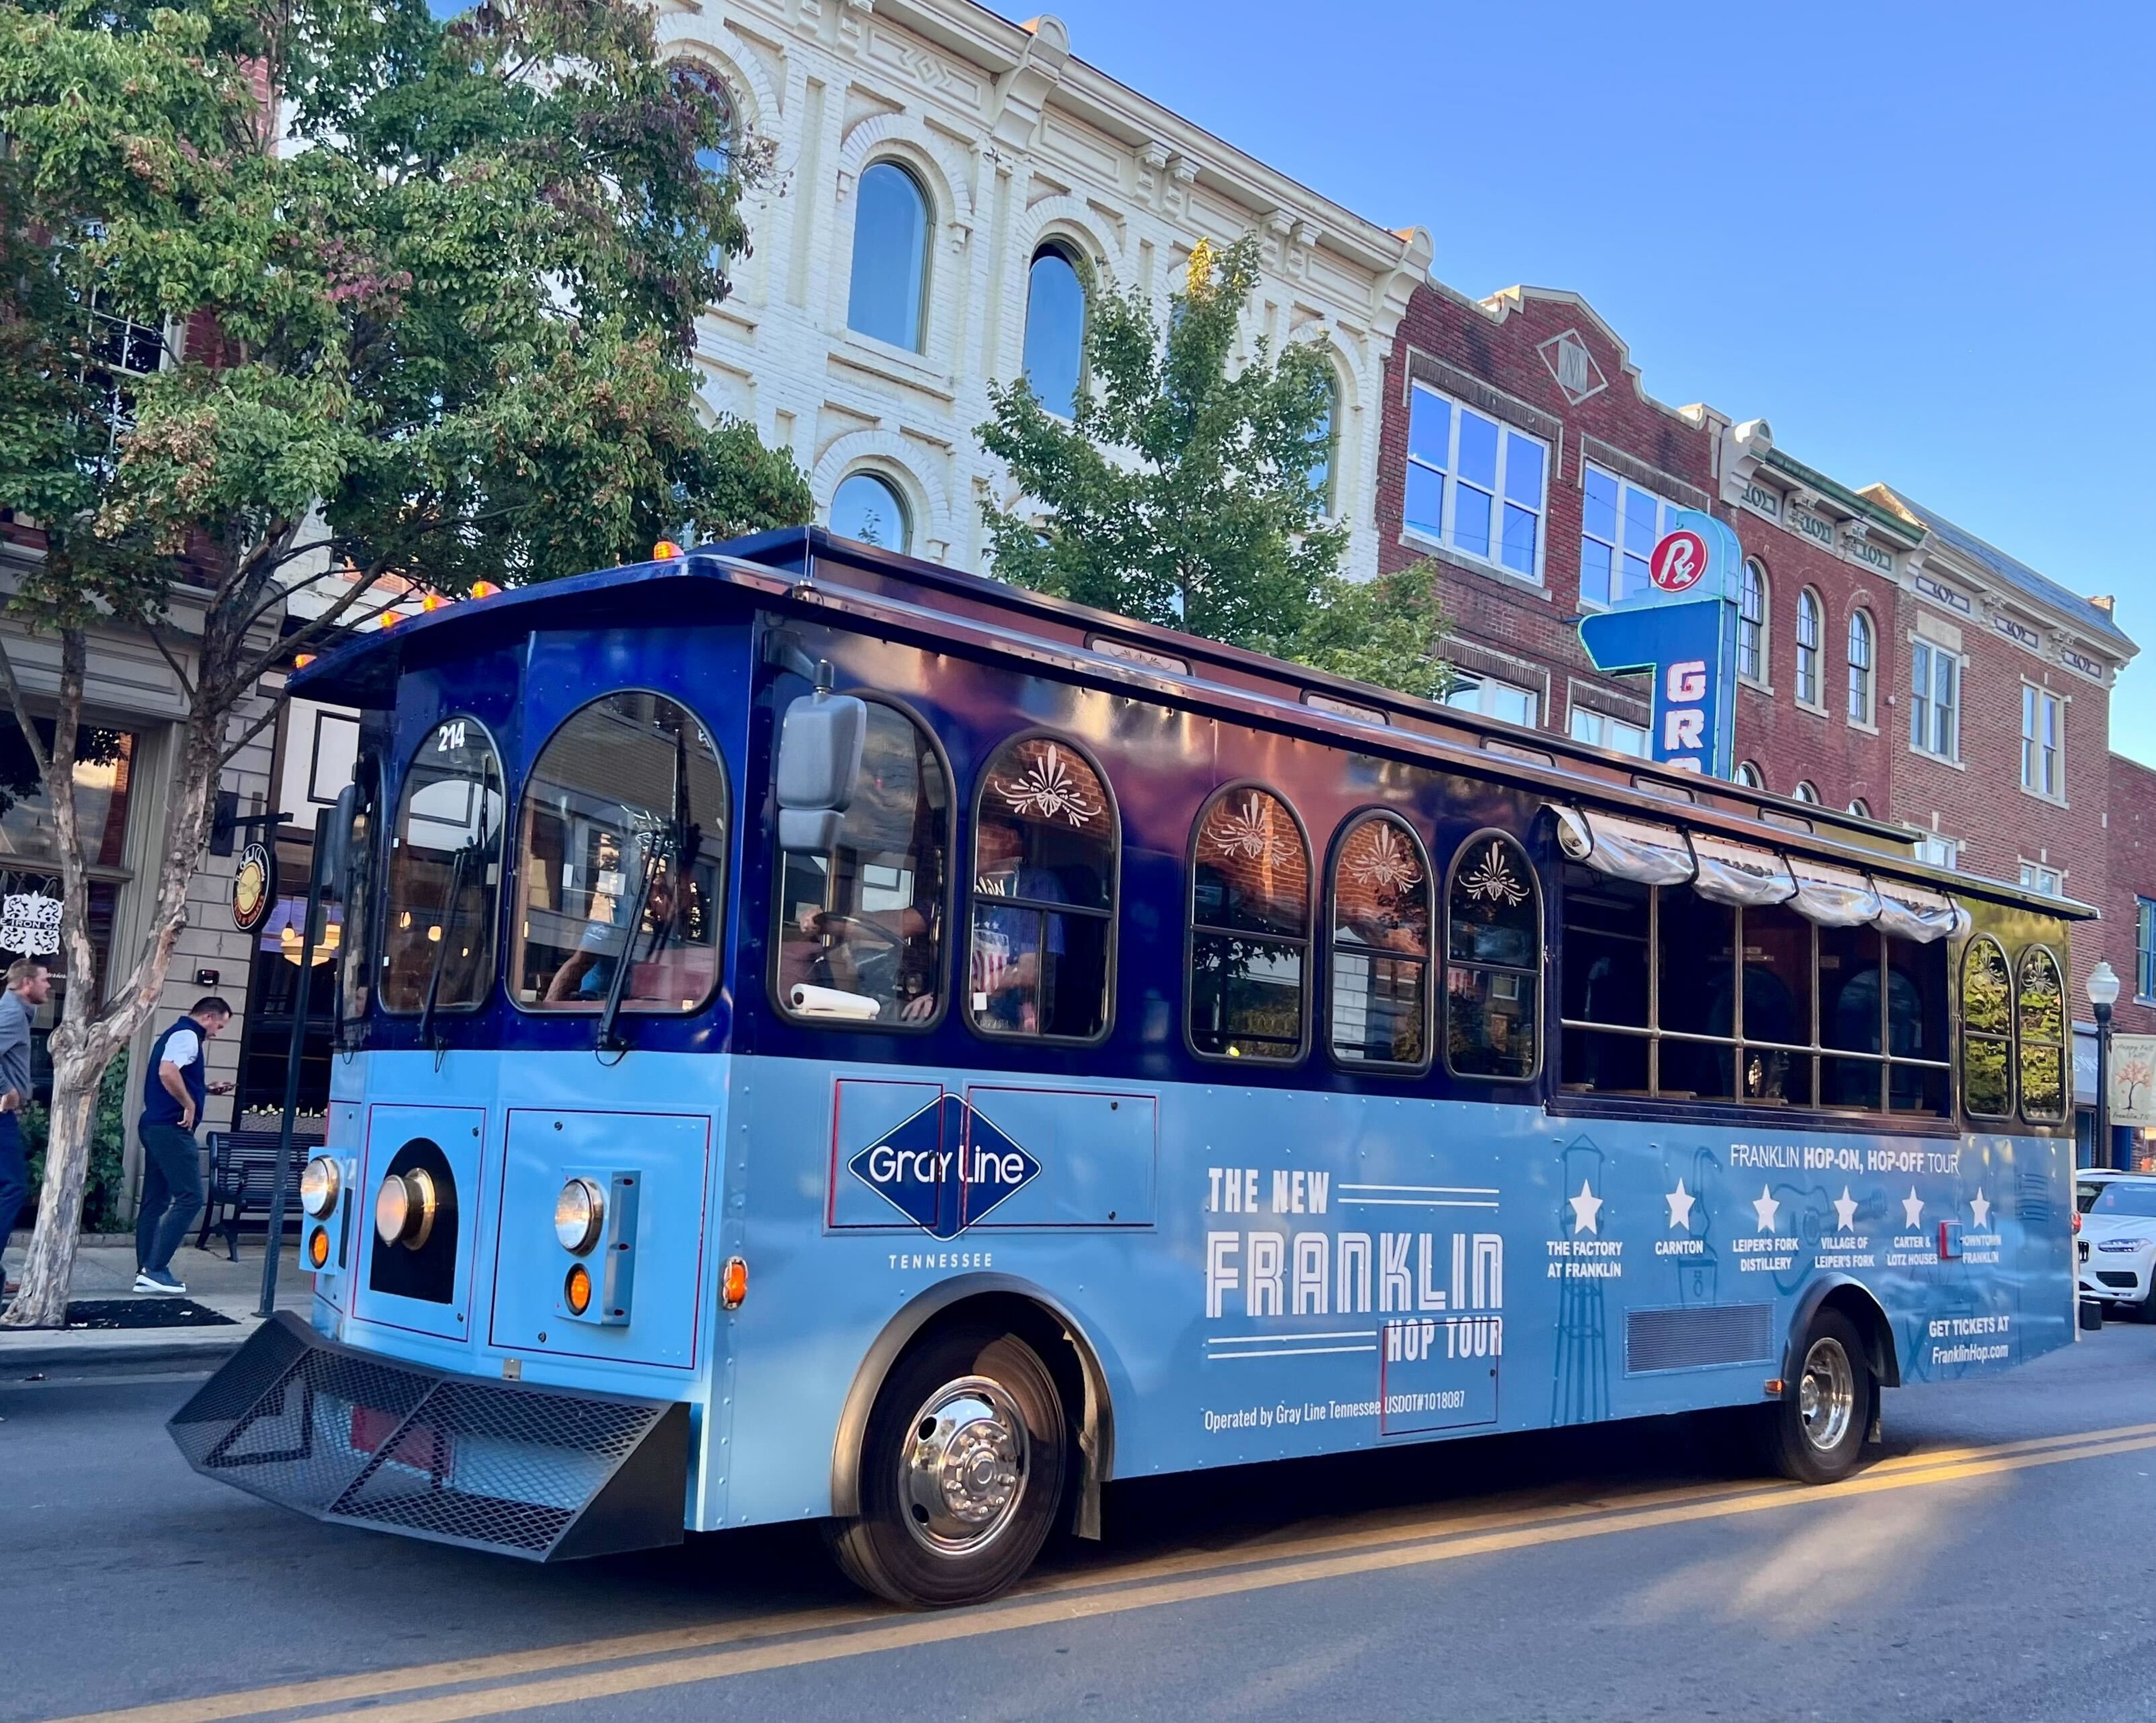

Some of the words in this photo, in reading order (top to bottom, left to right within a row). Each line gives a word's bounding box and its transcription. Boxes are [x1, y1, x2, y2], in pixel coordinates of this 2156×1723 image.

[438, 722, 465, 752] 214
[11, 919, 41, 929] IRON
[869, 1145, 953, 1183] Gray
[958, 1145, 1024, 1183] Line
[1730, 1144, 1799, 1168] FRANKLIN
[1803, 1146, 1863, 1174] HOP-ON,
[1867, 1150, 1925, 1173] HOP-OFF
[1927, 1153, 1959, 1174] TOUR
[1208, 1168, 1259, 1213] THE
[1272, 1169, 1330, 1214] NEW
[1546, 1241, 1570, 1256] THE
[1573, 1241, 1623, 1256] FACTORY
[1655, 1240, 1704, 1255] CARNTON
[1733, 1238, 1773, 1253] LEIPER'S
[1774, 1237, 1799, 1251] FORK
[1821, 1237, 1856, 1250] VILLAGE
[1857, 1236, 1869, 1249] OF
[1894, 1236, 1924, 1249] CARTER
[1925, 1236, 1931, 1247] &
[889, 1253, 992, 1269] TENNESSEE
[1741, 1256, 1793, 1272] DISTILLERY
[1815, 1255, 1852, 1269] LEIPER'S
[1853, 1254, 1875, 1268] FORK
[1886, 1253, 1907, 1267] LOTZ
[1908, 1253, 1939, 1265] HOUSES
[1962, 1251, 1999, 1264] FRANKLIN
[1205, 1231, 1504, 1318] FRANKLIN
[1547, 1262, 1563, 1278] AT
[1565, 1261, 1622, 1278] FRANKLIN
[1929, 1319, 1951, 1338] GET
[1952, 1317, 1995, 1336] TICKETS
[1997, 1315, 2010, 1332] AT
[1387, 1318, 1435, 1362] HOP
[1446, 1315, 1503, 1359] TOUR
[1932, 1343, 2009, 1365] FranklinHop.com
[1204, 1410, 1257, 1433] Operated
[1259, 1407, 1273, 1428] by
[1276, 1405, 1301, 1425] Gray
[1304, 1402, 1326, 1422] Line
[1328, 1400, 1381, 1419] Tennessee
[1385, 1390, 1465, 1414] USDOT#1018087
